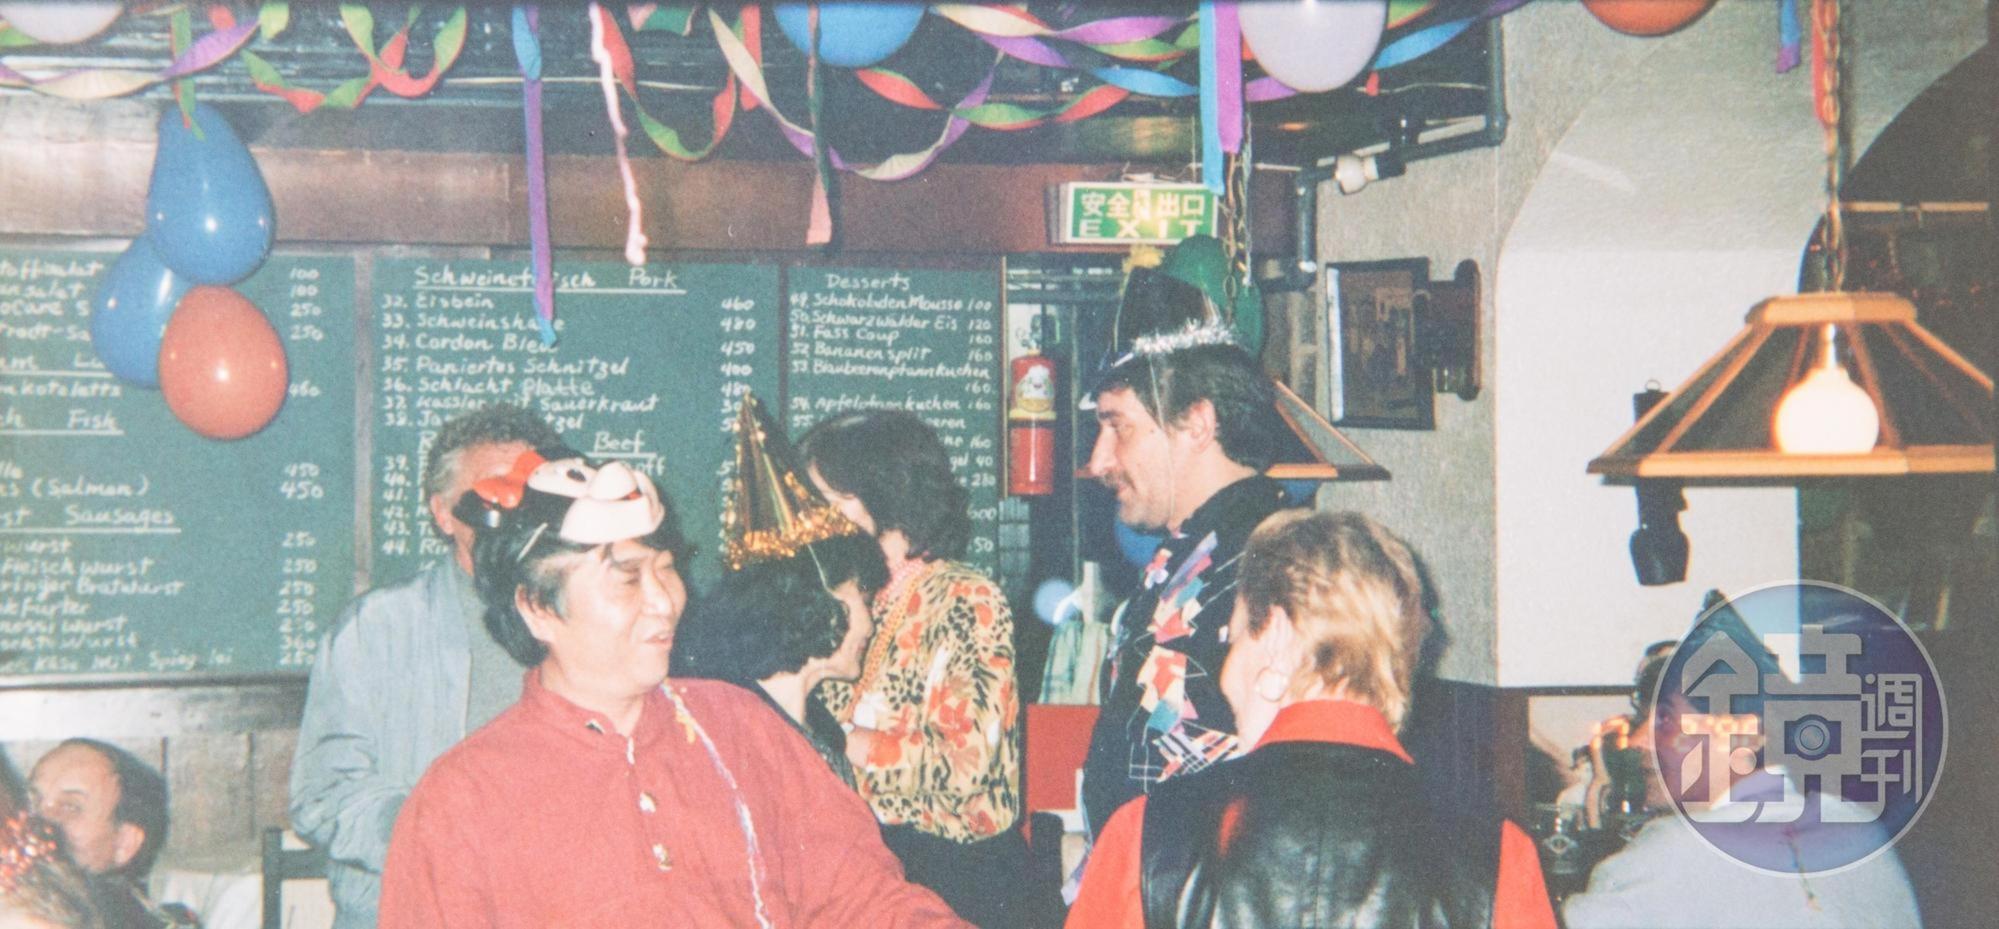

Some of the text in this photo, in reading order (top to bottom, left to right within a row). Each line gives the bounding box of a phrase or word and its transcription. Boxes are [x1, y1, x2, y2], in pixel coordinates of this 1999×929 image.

[1079, 219, 1203, 240] EXIT
[627, 266, 677, 288] Pork
[826, 272, 911, 291] Desserts
[416, 313, 566, 331] Schweinshae
[593, 429, 645, 455] Beef
[280, 481, 324, 500] 450
[64, 503, 176, 530] Sausages
